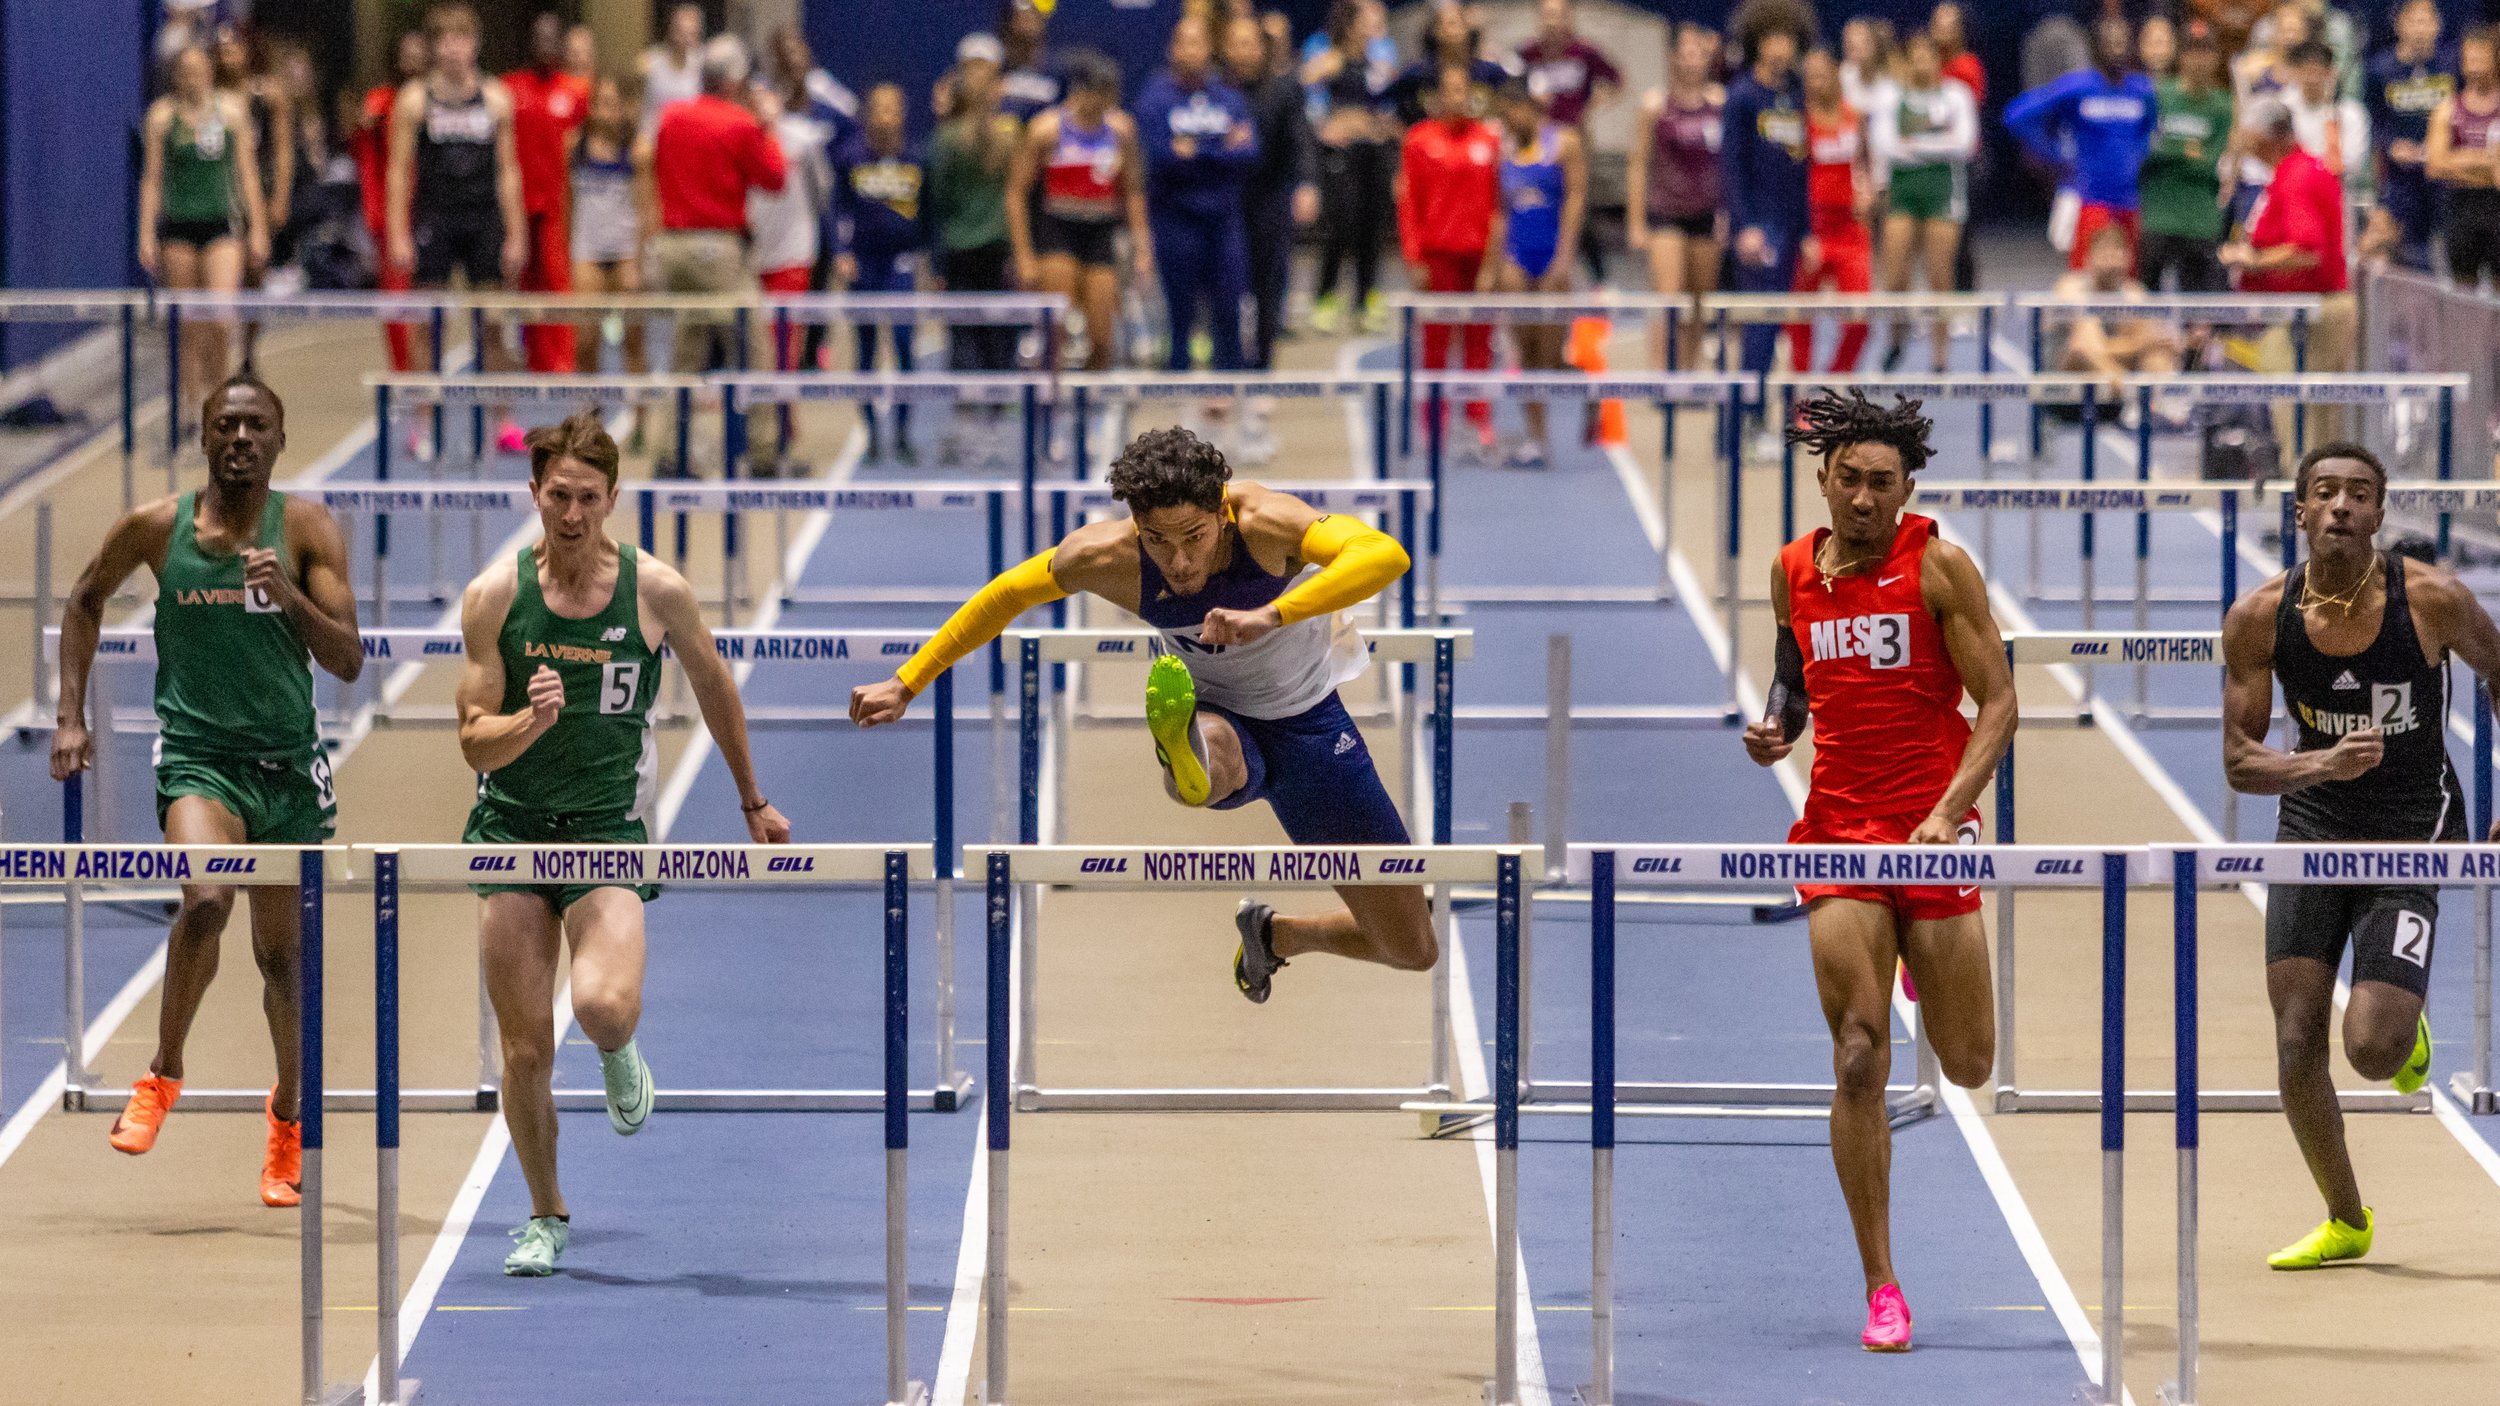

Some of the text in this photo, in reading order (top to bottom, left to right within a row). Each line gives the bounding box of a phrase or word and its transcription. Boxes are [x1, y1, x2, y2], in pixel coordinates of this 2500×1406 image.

[525, 641, 613, 665] LA VERNE
[753, 638, 849, 659] ARIZONA
[1879, 618, 1902, 666] 3
[2071, 638, 2214, 662] GILL NORTHERN
[611, 667, 633, 711] 5
[2381, 688, 2402, 724] 2
[74, 850, 192, 880] ARIZONA
[205, 857, 257, 874] GILL
[469, 850, 815, 880] GILL NORTHERN ARIZONA GILL
[1080, 852, 1426, 881] GILL NORTHERN ARIZONA GILL
[1633, 852, 2084, 880] GILL NORTHERN ARIZONA GILL
[2215, 857, 2265, 873] GILL
[2303, 852, 2449, 879] NORTHERN
[2401, 916, 2424, 961] 2
